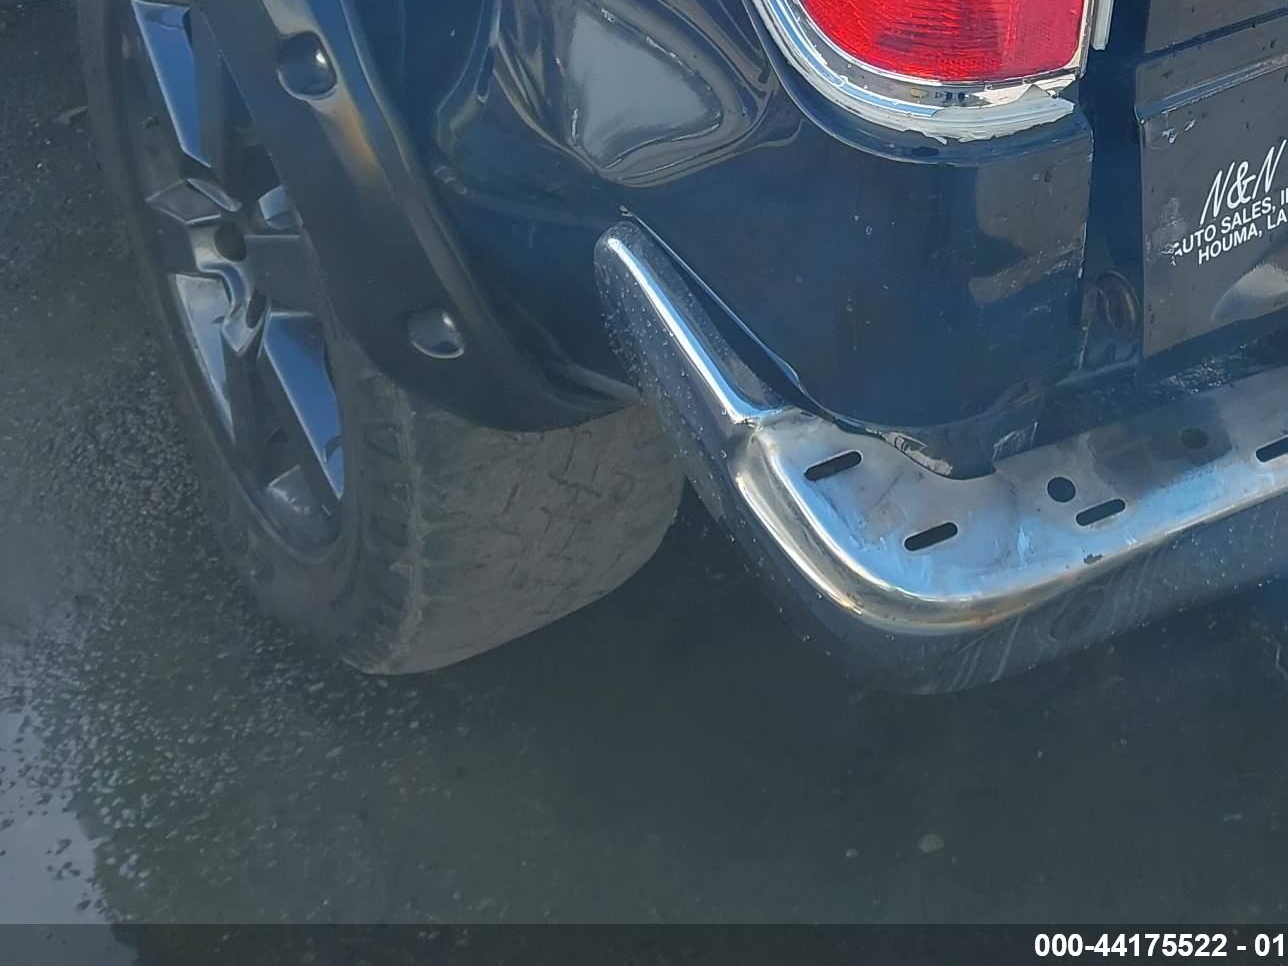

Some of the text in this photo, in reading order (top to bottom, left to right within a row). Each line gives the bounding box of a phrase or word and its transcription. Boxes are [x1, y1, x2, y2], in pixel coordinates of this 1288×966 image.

[1200, 139, 1287, 226] N&N
[1198, 208, 1287, 265] HOUMA, LA
[1221, 196, 1276, 234] SALES,
